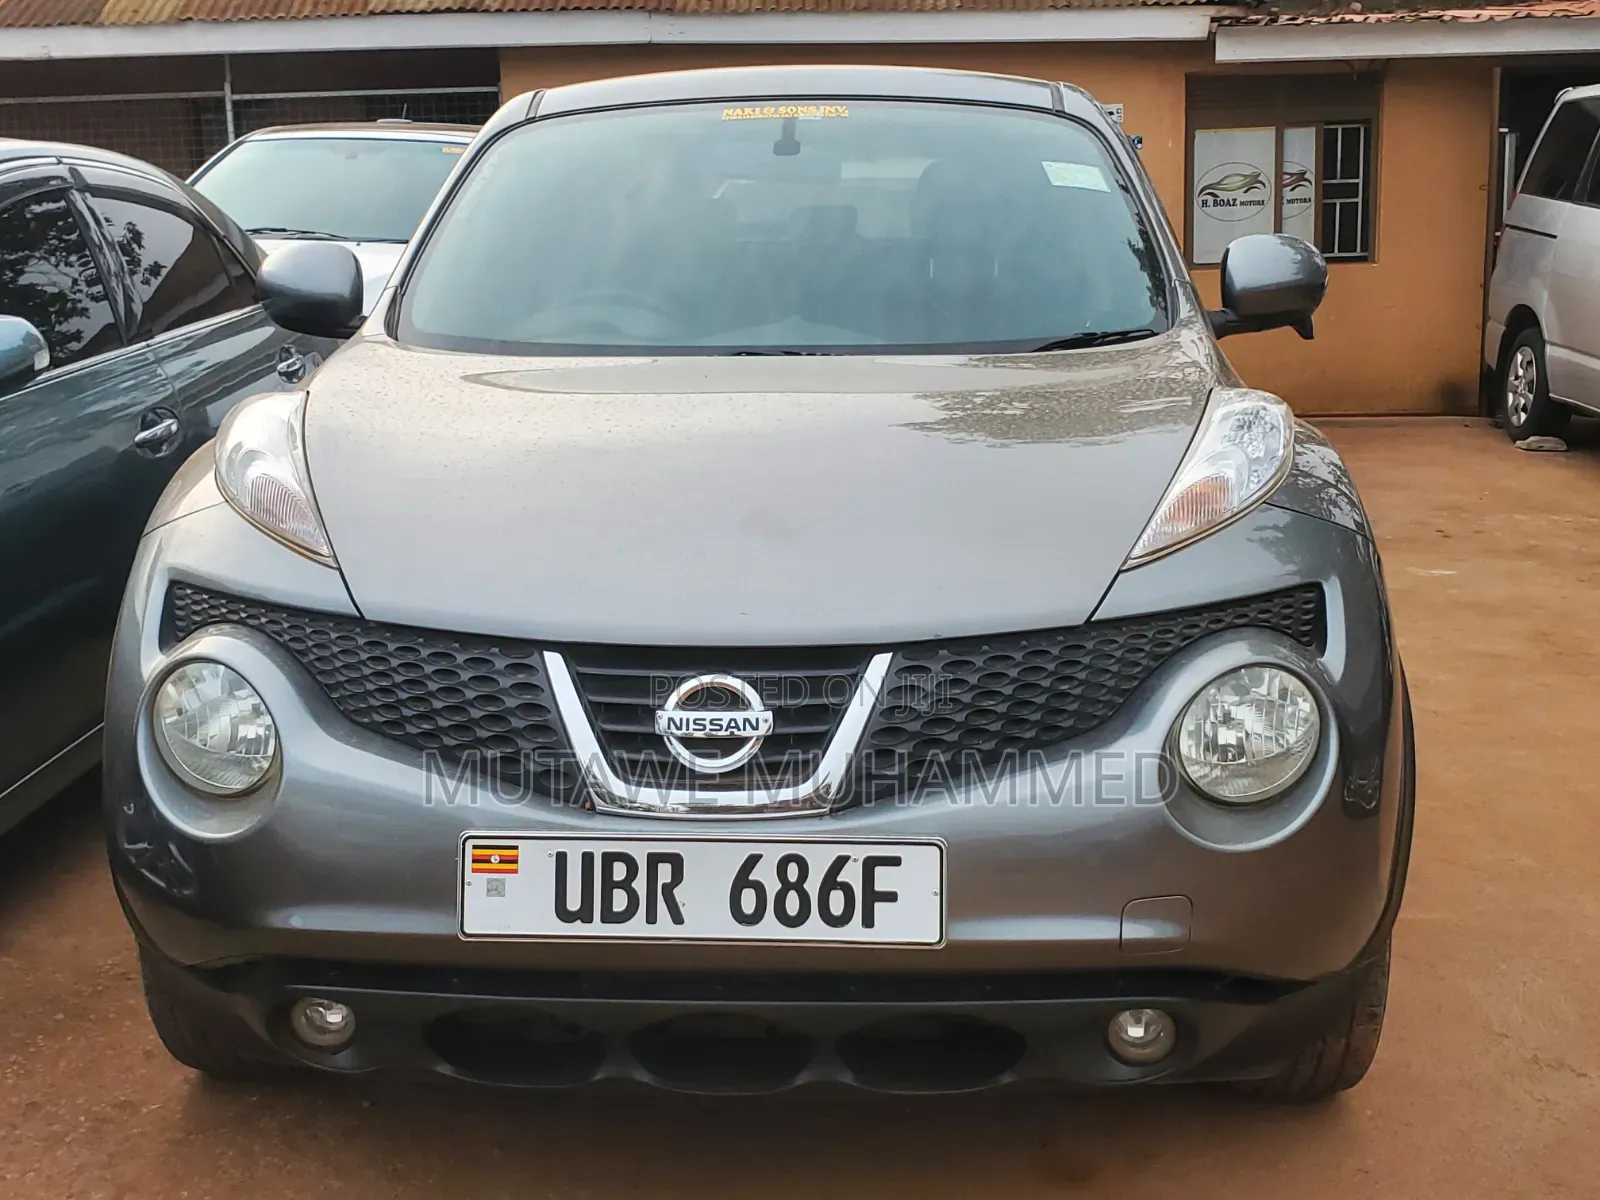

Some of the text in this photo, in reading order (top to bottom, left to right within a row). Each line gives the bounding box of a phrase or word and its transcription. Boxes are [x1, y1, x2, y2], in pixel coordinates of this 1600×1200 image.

[723, 107, 760, 116] NAKI
[778, 106, 816, 116] SONS
[1201, 198, 1265, 208] H. BOAZ MOTORS
[666, 717, 760, 732] NISSAN
[554, 850, 903, 929] UBR 686F
